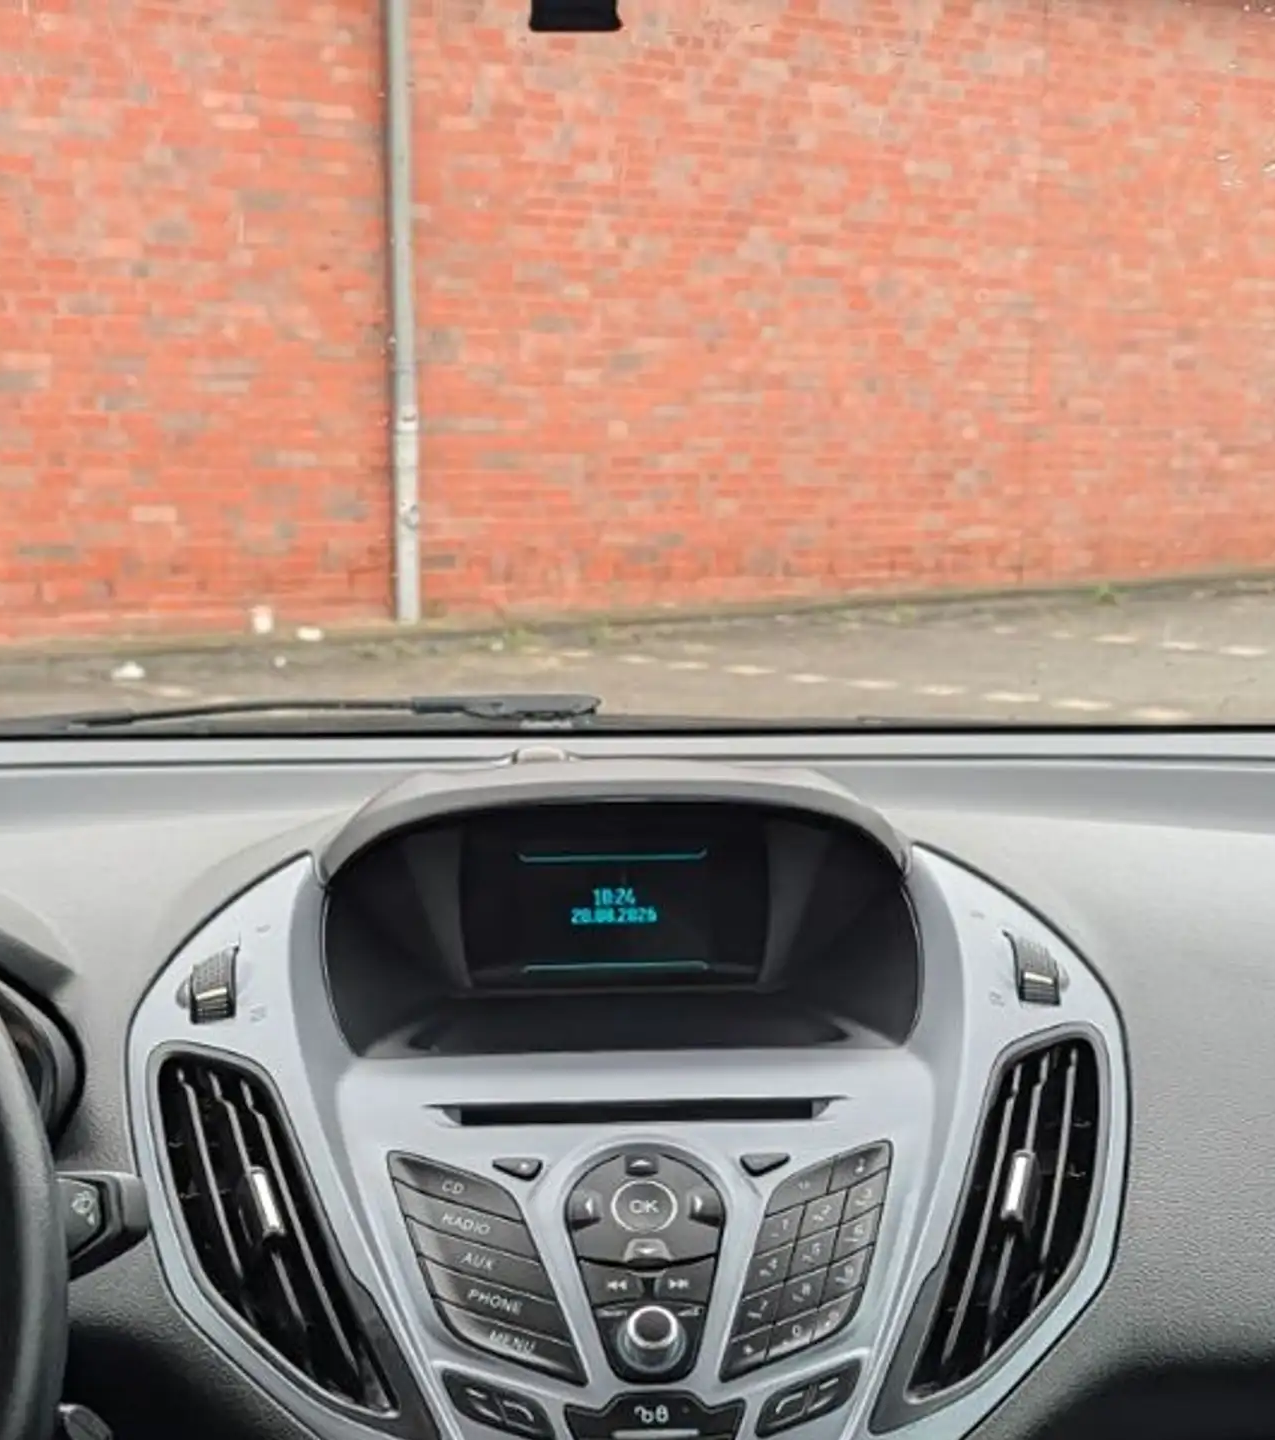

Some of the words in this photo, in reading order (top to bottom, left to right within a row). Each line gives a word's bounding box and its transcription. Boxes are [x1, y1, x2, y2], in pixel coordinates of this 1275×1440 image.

[442, 1180, 465, 1195] CD
[629, 1199, 660, 1214] OK
[442, 1212, 491, 1235] RADIO
[460, 1252, 494, 1271] AUX
[467, 1288, 525, 1316] PHONE
[489, 1330, 537, 1354] MENU
